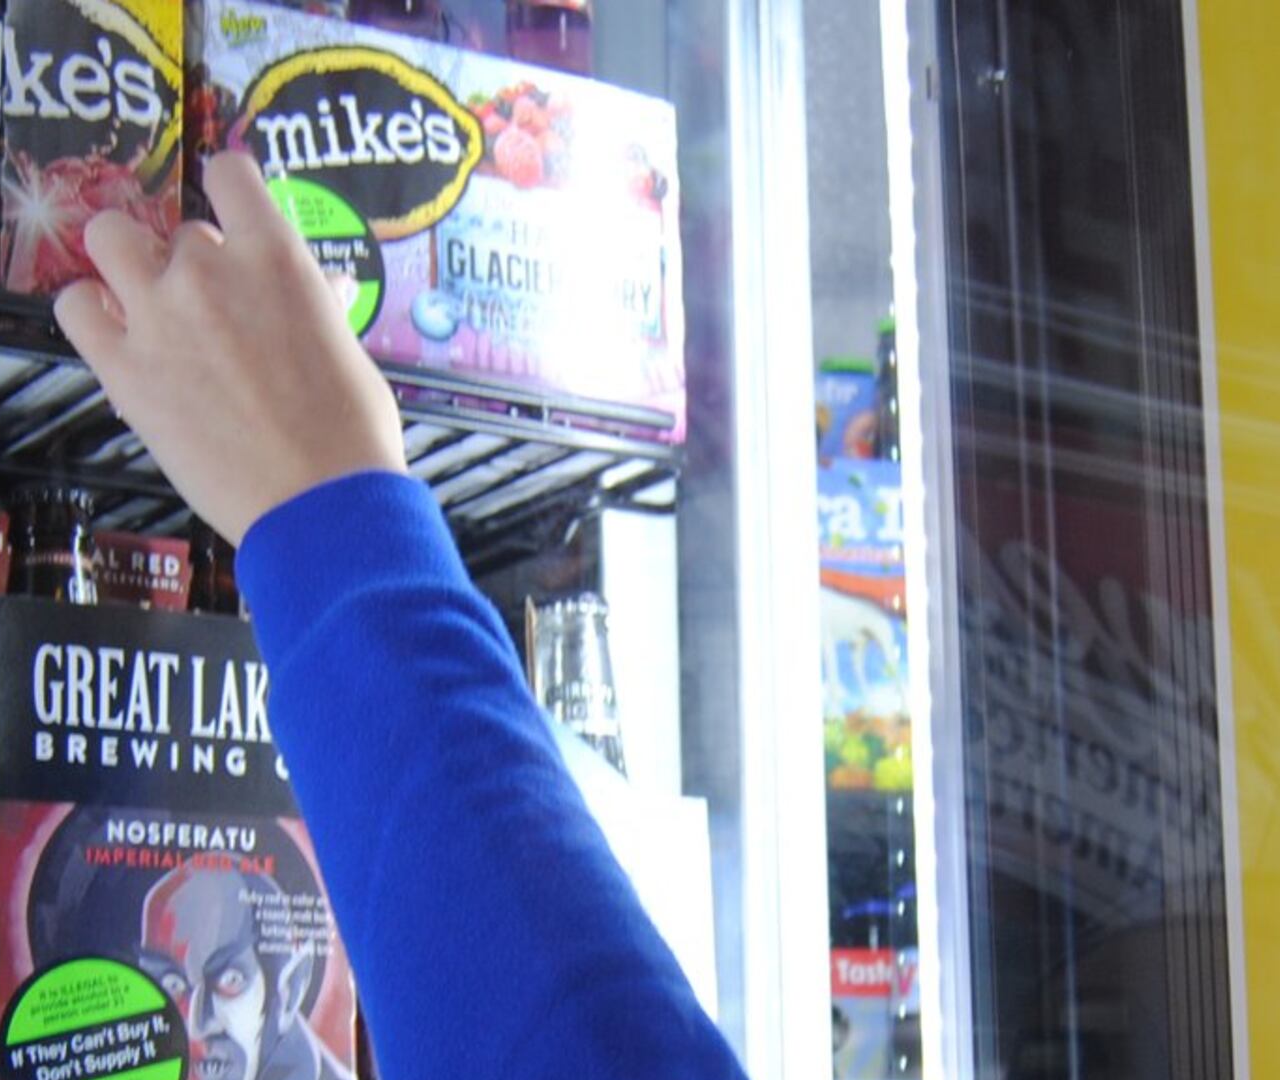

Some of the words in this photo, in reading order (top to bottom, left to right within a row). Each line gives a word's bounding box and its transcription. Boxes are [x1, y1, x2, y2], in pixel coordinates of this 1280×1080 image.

[256, 94, 461, 170] mike's
[131, 551, 180, 577] RED
[33, 643, 179, 734] GREAT
[190, 655, 275, 744] LAK
[34, 730, 248, 778] BREWING
[106, 818, 257, 853] NOSFERATU
[85, 846, 186, 871] IMPERIAL
[10, 1046, 24, 1069] If
[26, 1041, 68, 1064] They
[71, 1027, 115, 1053] Can't
[117, 1019, 150, 1042] Buy
[84, 1045, 141, 1075] Supply
[143, 1039, 157, 1060] It
